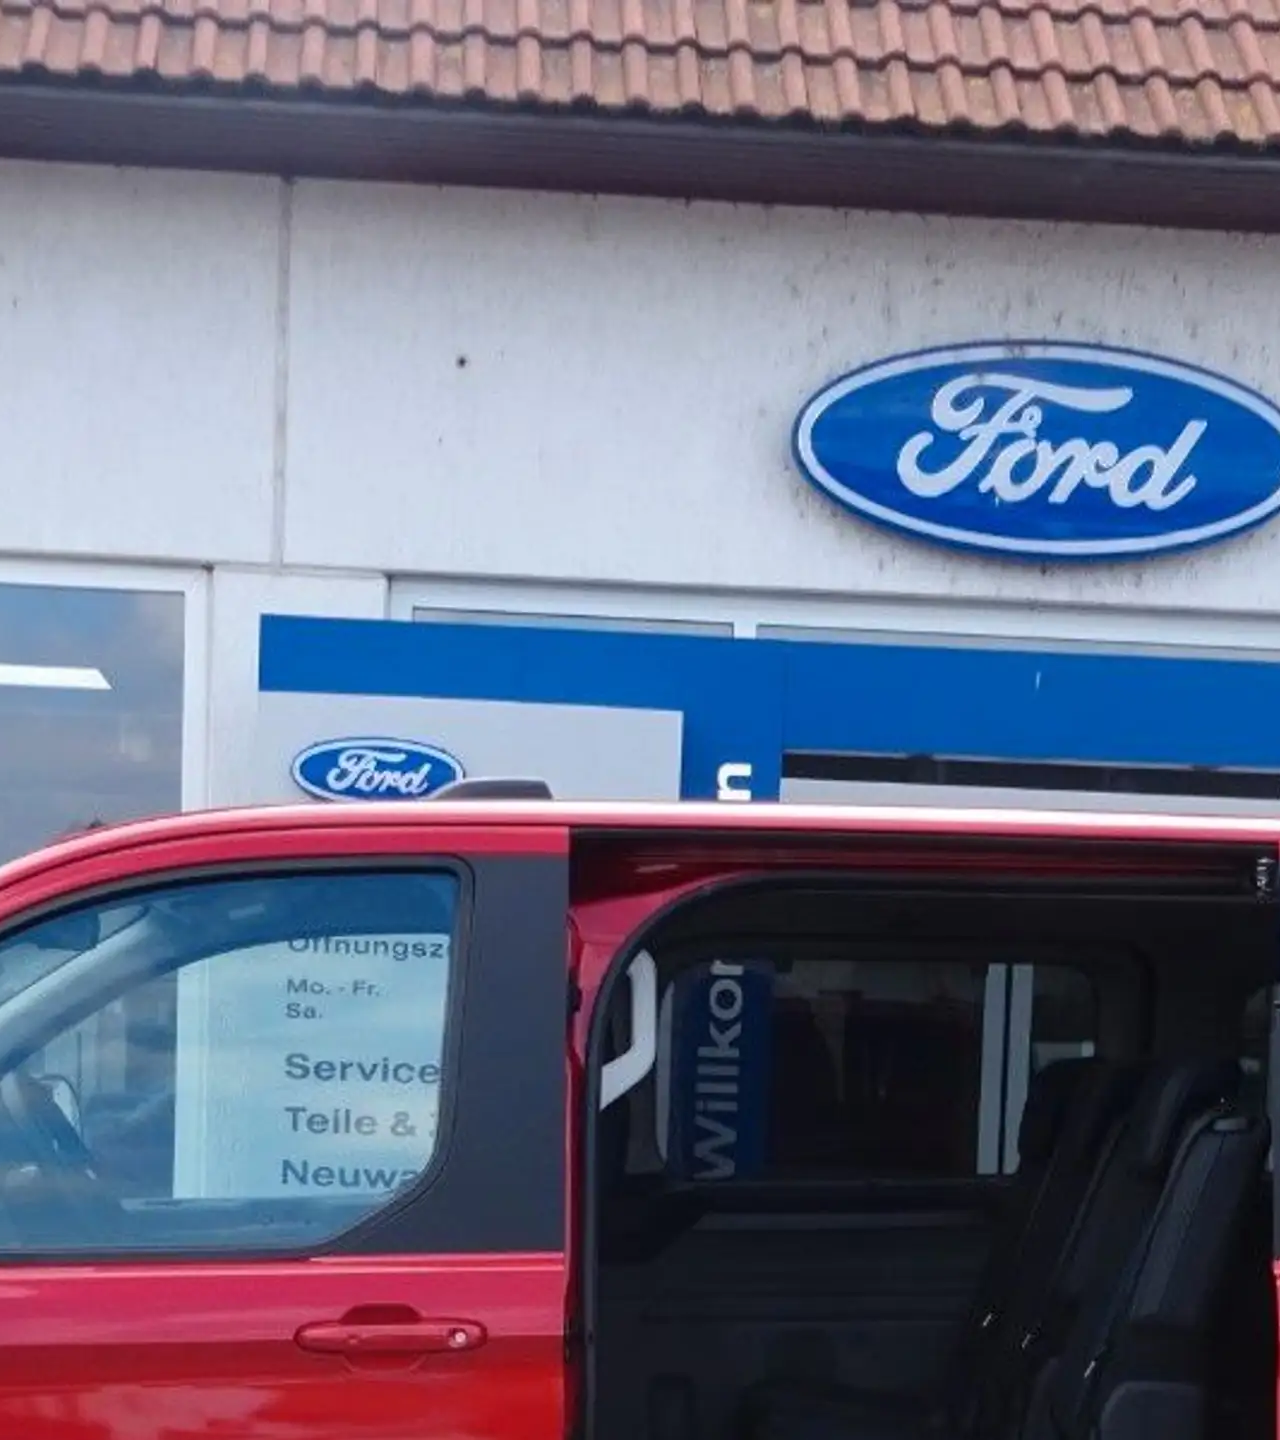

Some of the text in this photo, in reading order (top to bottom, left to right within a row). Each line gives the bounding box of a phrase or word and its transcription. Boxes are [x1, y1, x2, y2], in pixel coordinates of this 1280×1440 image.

[897, 372, 1208, 511] Ford
[326, 748, 432, 794] Ford
[286, 978, 331, 996] Mo.
[352, 979, 381, 998] Fr.
[285, 1003, 323, 1020] Sa.
[284, 1052, 441, 1084] Service
[284, 1106, 379, 1136] Teile
[390, 1110, 417, 1137] &
